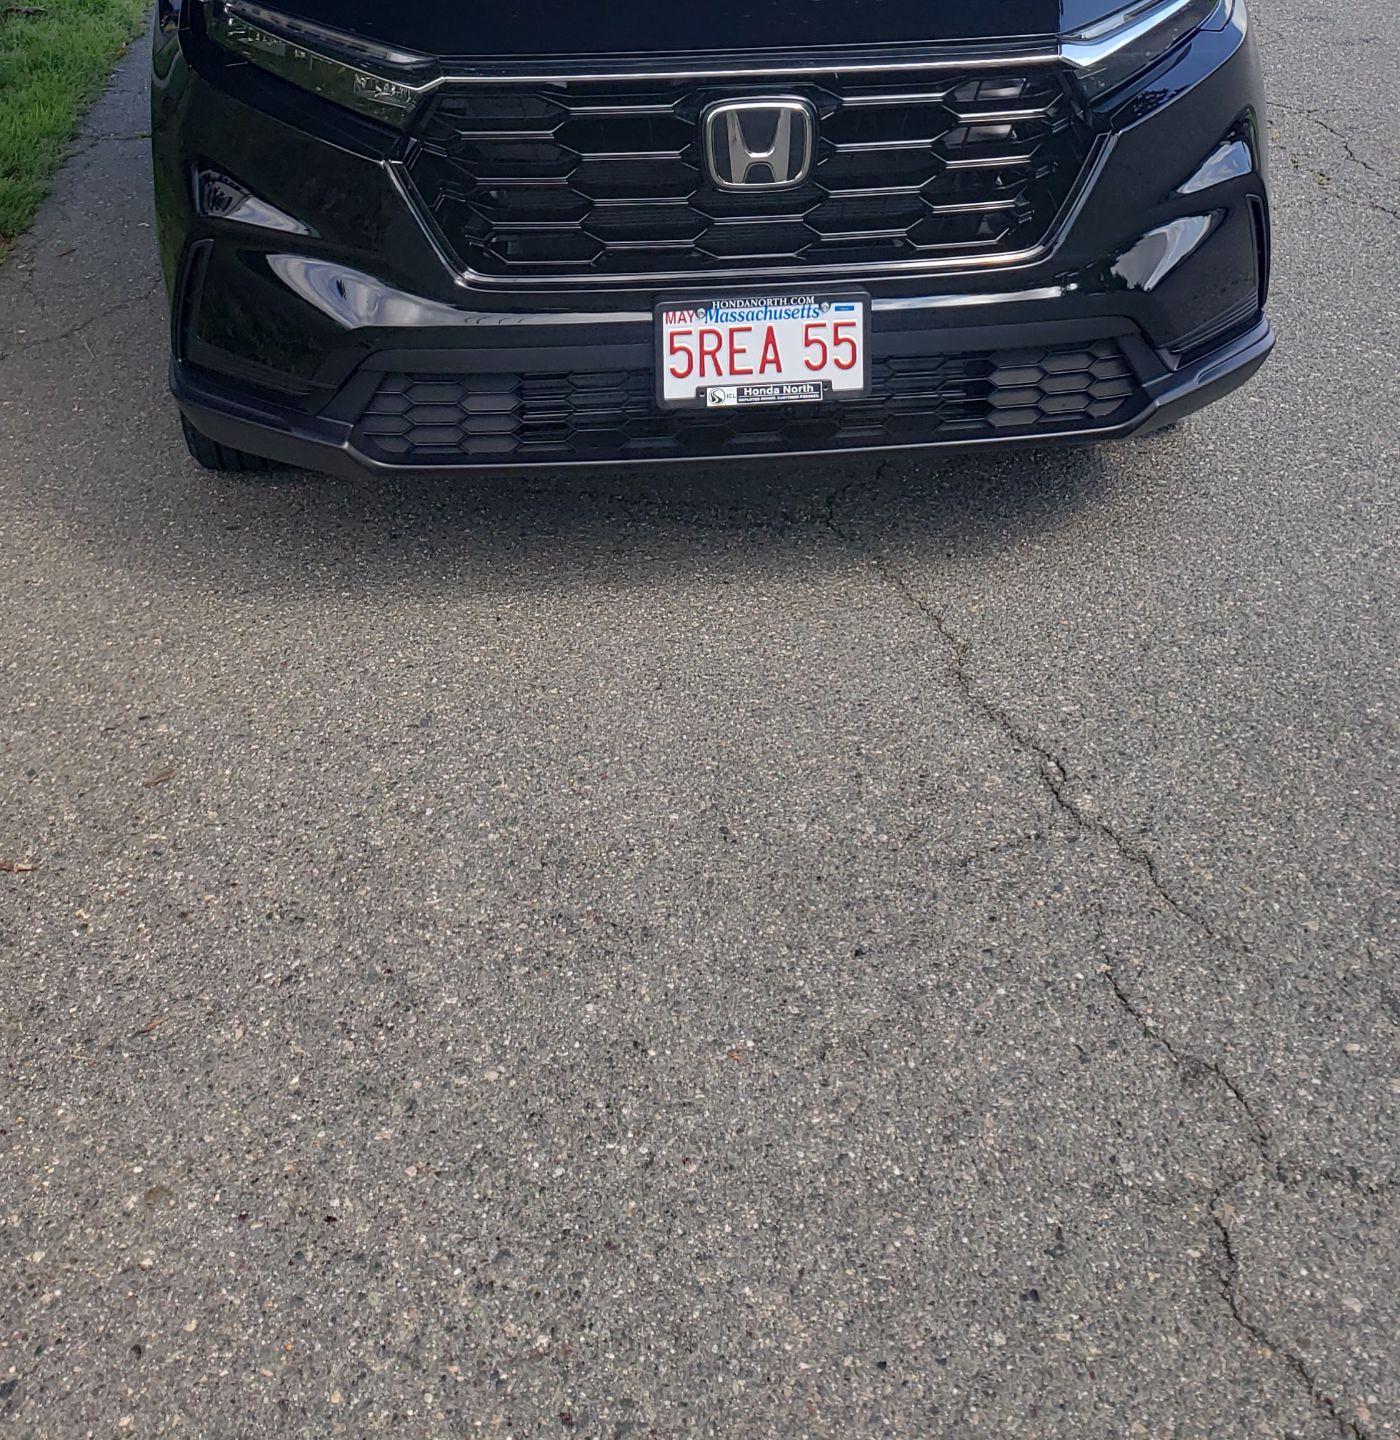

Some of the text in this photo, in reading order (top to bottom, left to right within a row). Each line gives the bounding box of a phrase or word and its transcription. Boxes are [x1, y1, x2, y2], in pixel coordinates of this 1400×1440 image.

[712, 296, 815, 309] HONDANORTH.COM
[665, 310, 696, 325] MAY
[704, 303, 820, 324] Massachusetts
[669, 321, 857, 379] 5REA 55
[743, 384, 814, 396] Honda North
